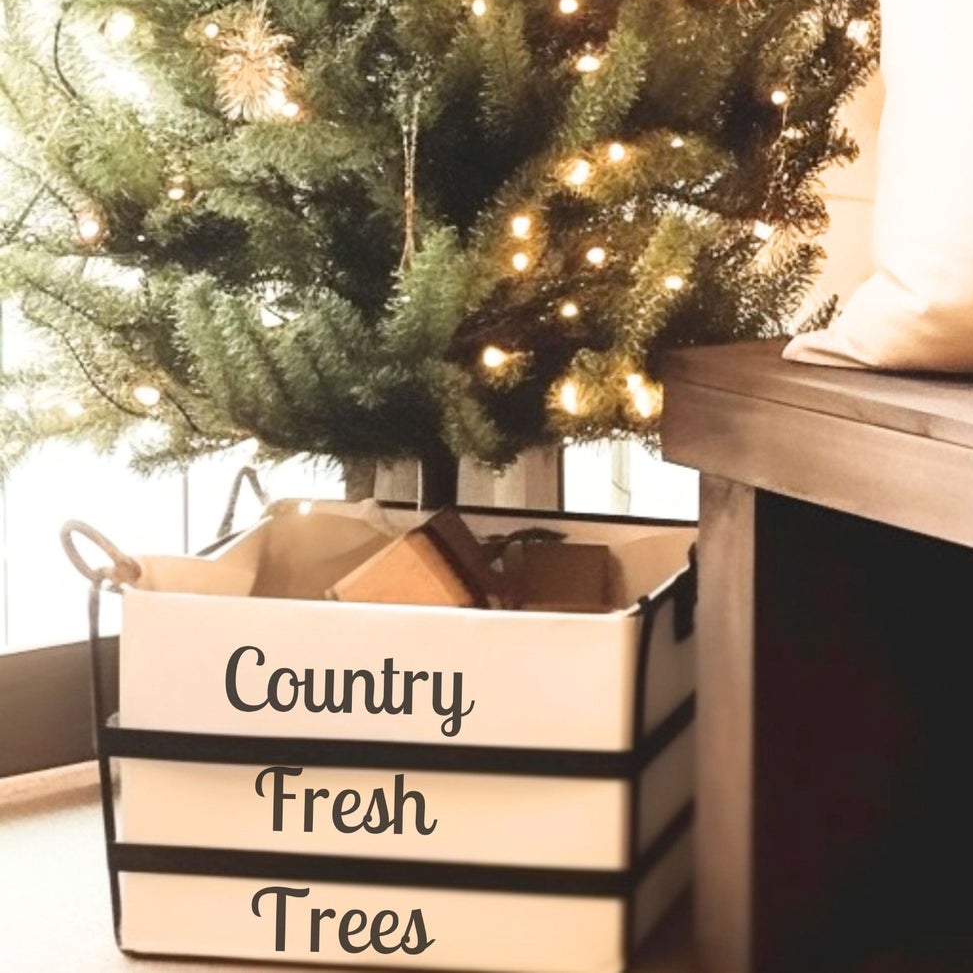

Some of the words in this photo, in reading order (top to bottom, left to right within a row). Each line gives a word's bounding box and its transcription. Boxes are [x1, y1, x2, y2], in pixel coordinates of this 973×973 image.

[225, 645, 475, 738] Country
[254, 766, 438, 836] Fresh
[251, 886, 436, 956] Trees
